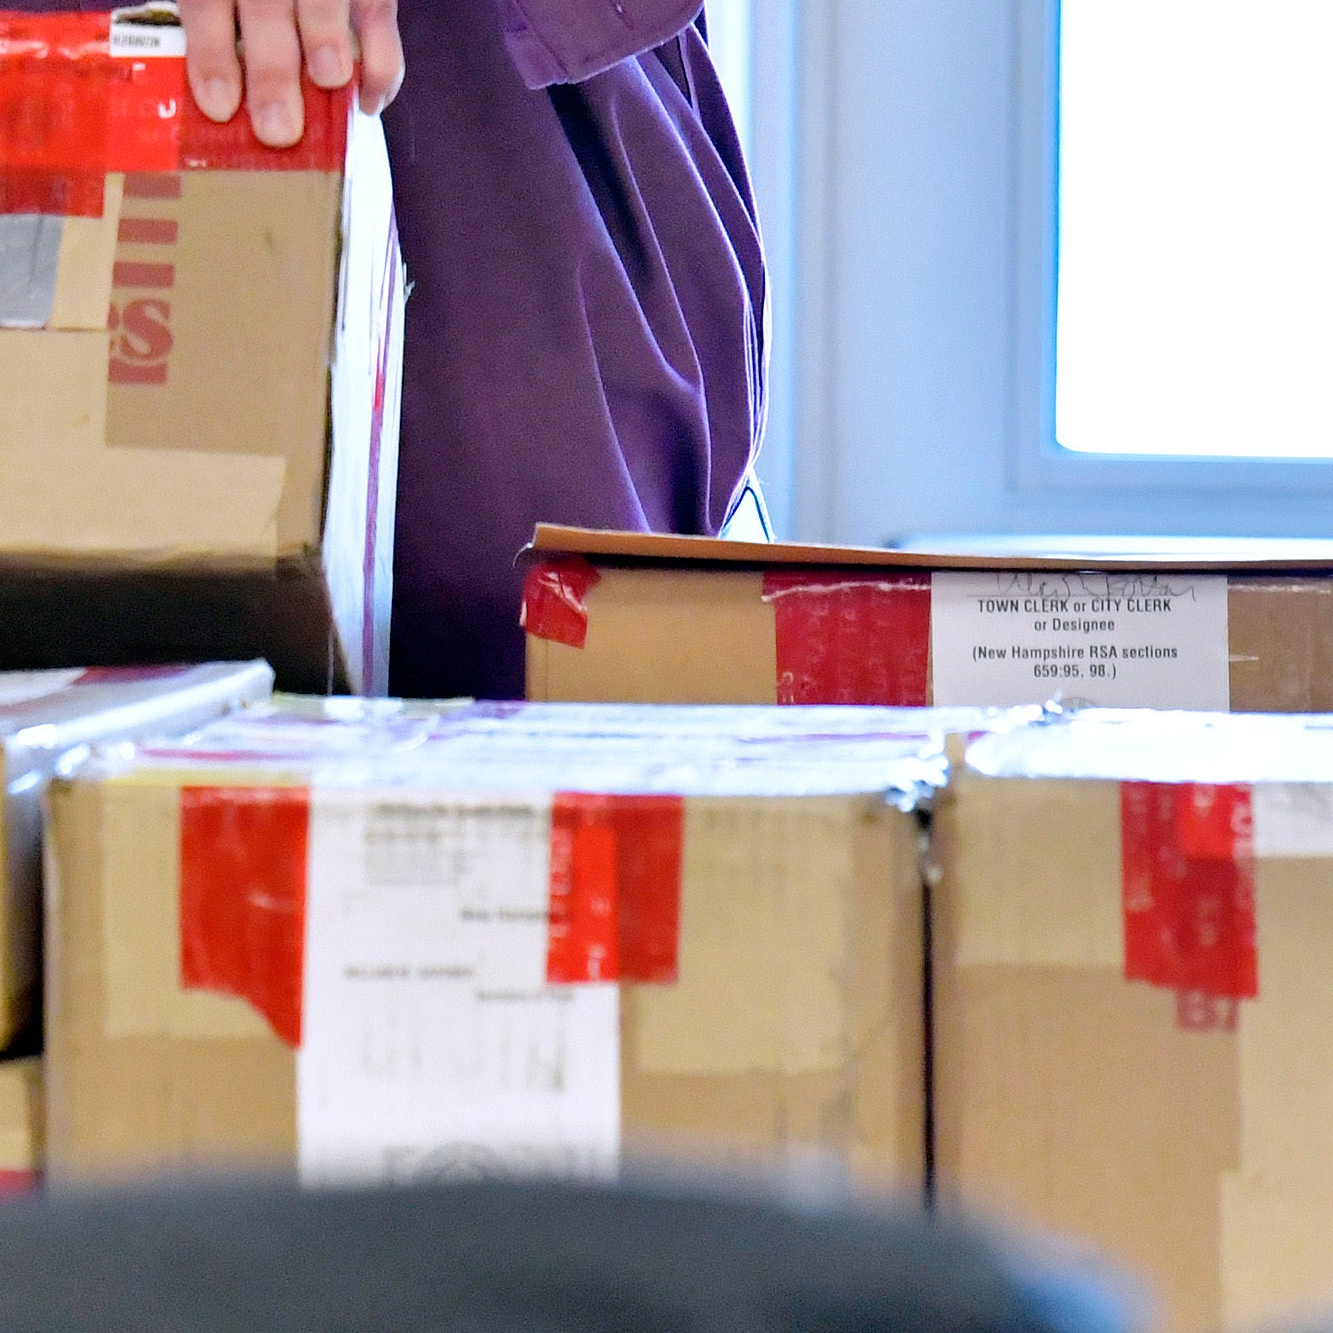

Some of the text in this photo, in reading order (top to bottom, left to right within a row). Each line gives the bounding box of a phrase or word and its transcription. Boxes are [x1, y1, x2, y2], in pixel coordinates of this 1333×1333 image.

[977, 599, 1172, 613] TOWN CLERK or CITY CLERK
[1034, 618, 1115, 633] or Designee
[972, 645, 1178, 662] (New Hampshire RSA sections
[1033, 664, 1117, 680] 659:95, 98.)
